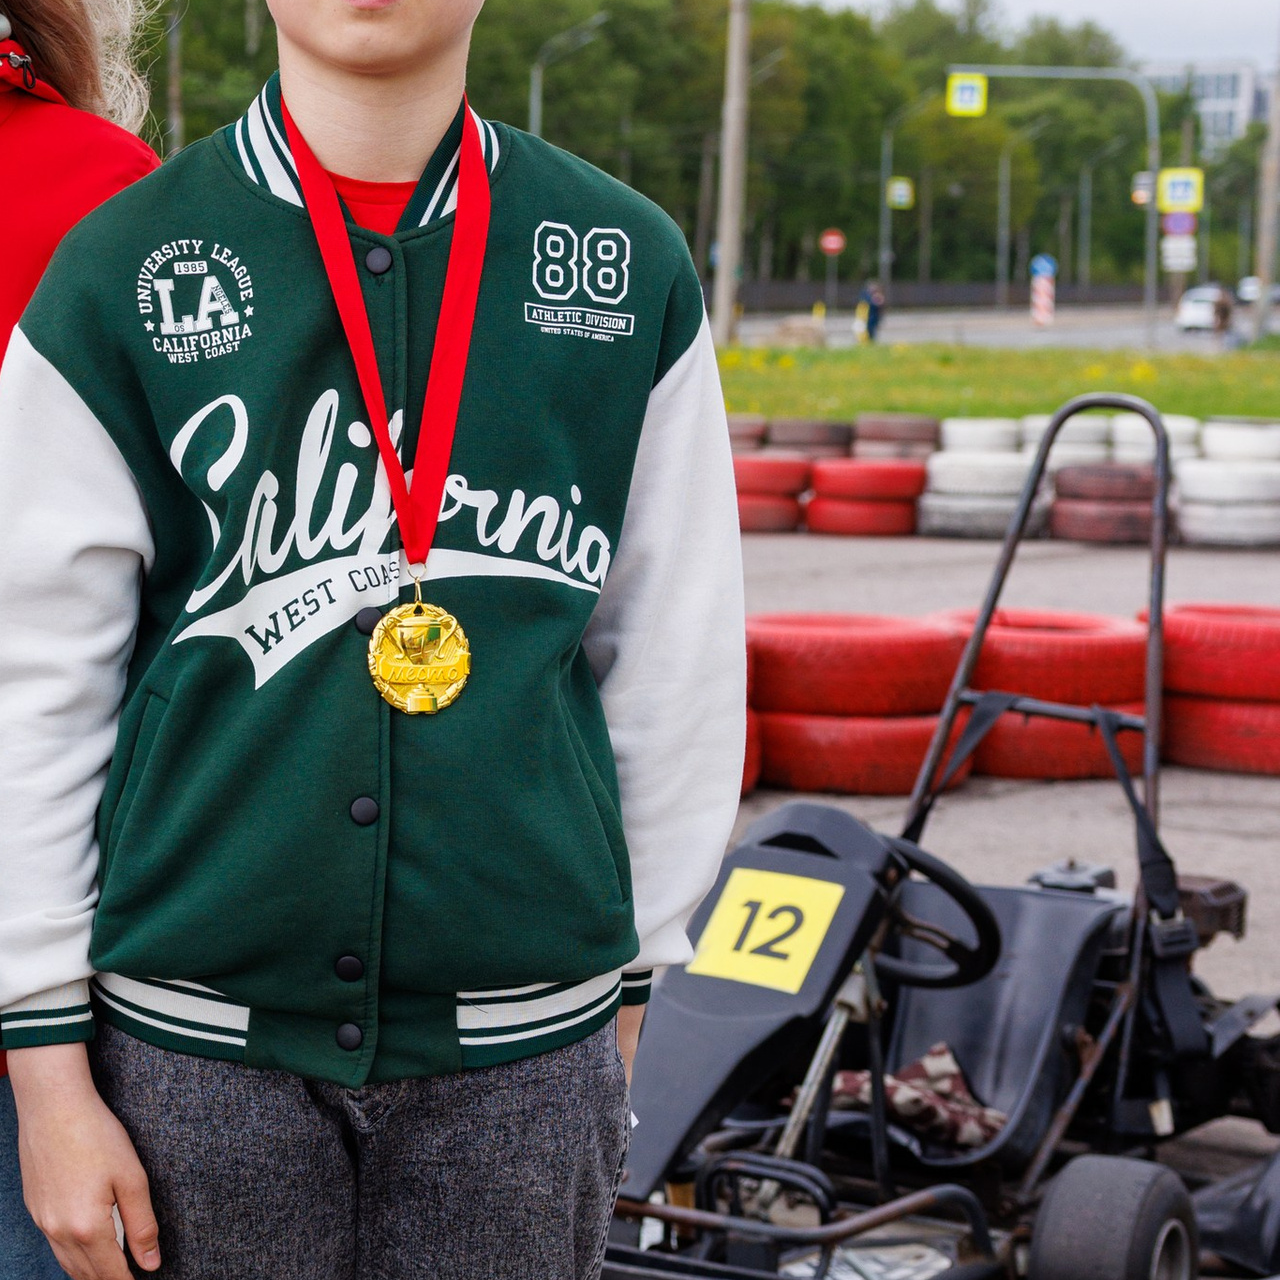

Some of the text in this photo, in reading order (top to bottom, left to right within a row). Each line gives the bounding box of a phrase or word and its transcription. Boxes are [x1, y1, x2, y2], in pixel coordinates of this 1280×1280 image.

[137, 240, 254, 314] UNIVERSITY LEAGUE
[176, 262, 205, 273] 1985
[532, 220, 631, 305] 88
[153, 275, 240, 335] LA
[532, 309, 627, 330] ATHLETIC DIVISION
[152, 323, 253, 353] CALIFORNIA
[167, 341, 240, 364] WEST COAST
[540, 326, 561, 335] UNITED
[563, 329, 584, 338] STATES
[591, 333, 615, 342] AMERICA
[244, 560, 400, 655] WEST COAS
[732, 900, 805, 961] 12
